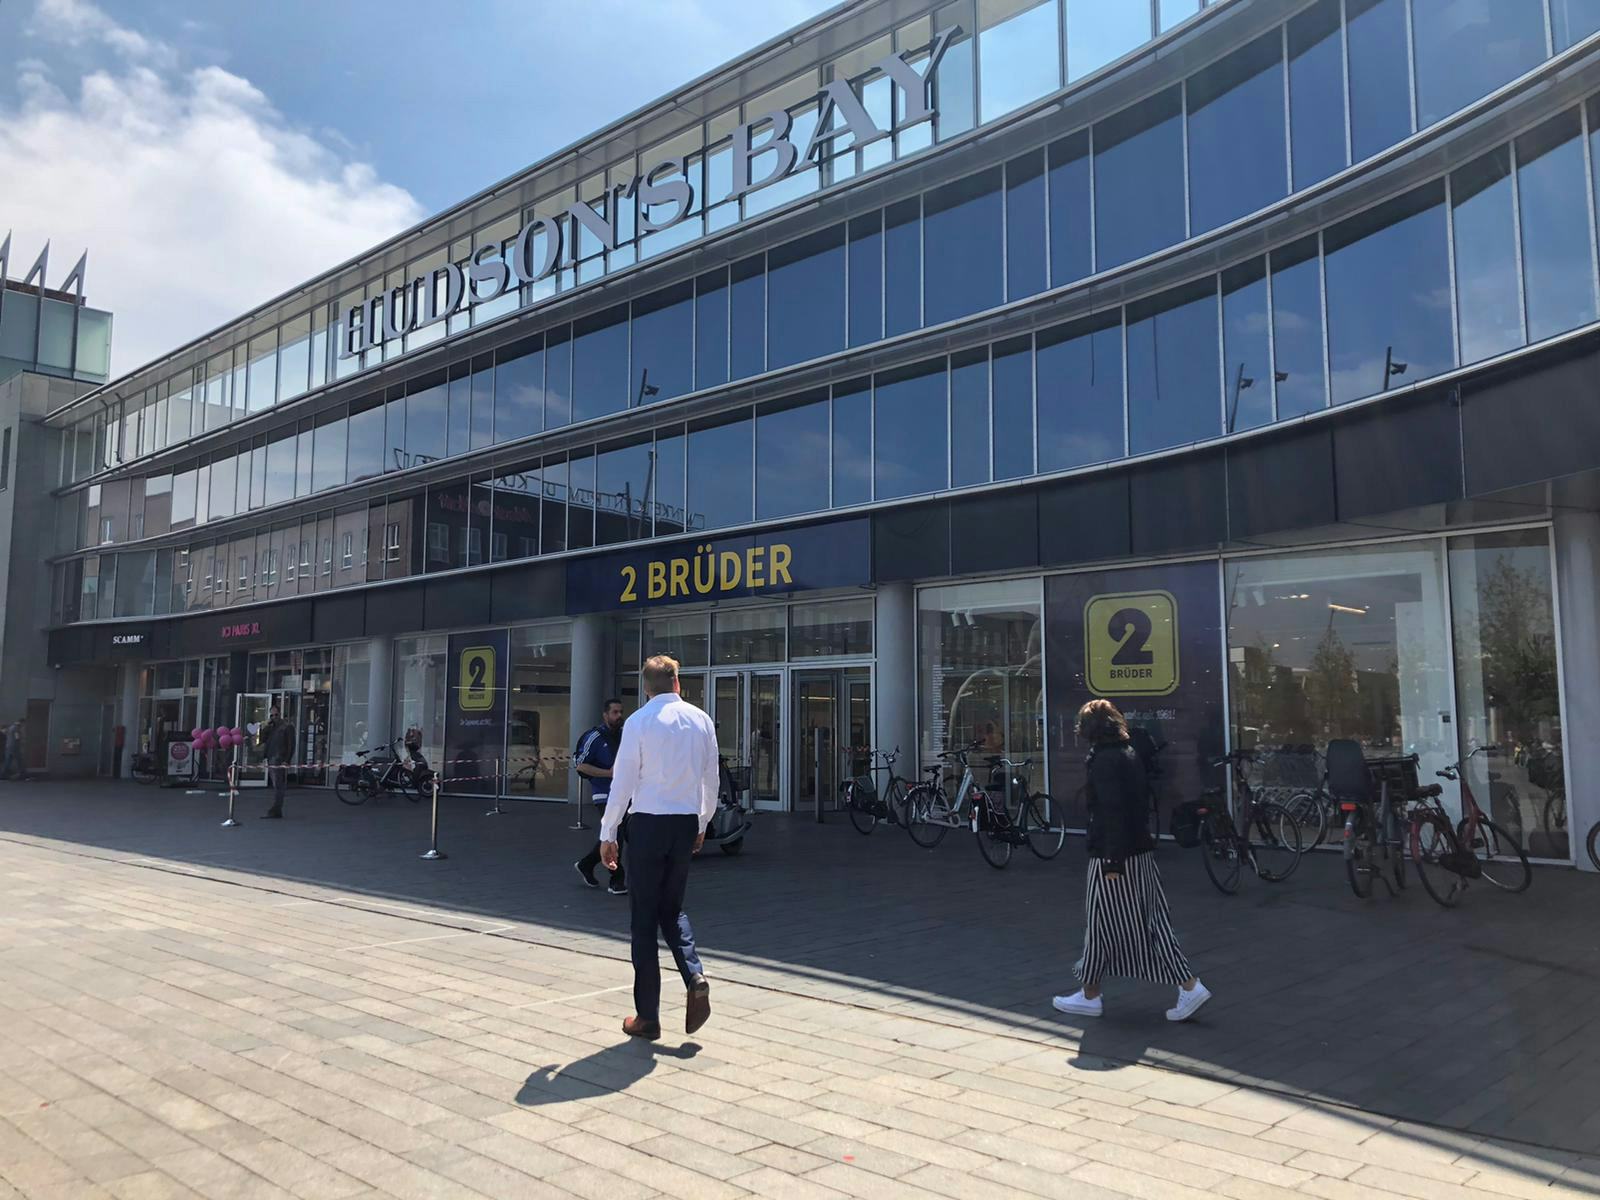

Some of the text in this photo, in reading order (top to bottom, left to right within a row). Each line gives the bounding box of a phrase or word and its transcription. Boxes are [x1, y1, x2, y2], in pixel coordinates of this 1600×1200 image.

[338, 24, 963, 360] HUDSON'S BAY
[620, 543, 793, 602] 2 BRÜDER
[1108, 607, 1154, 666] 2
[469, 656, 486, 692] 2
[1110, 667, 1153, 679] BRÜDER
